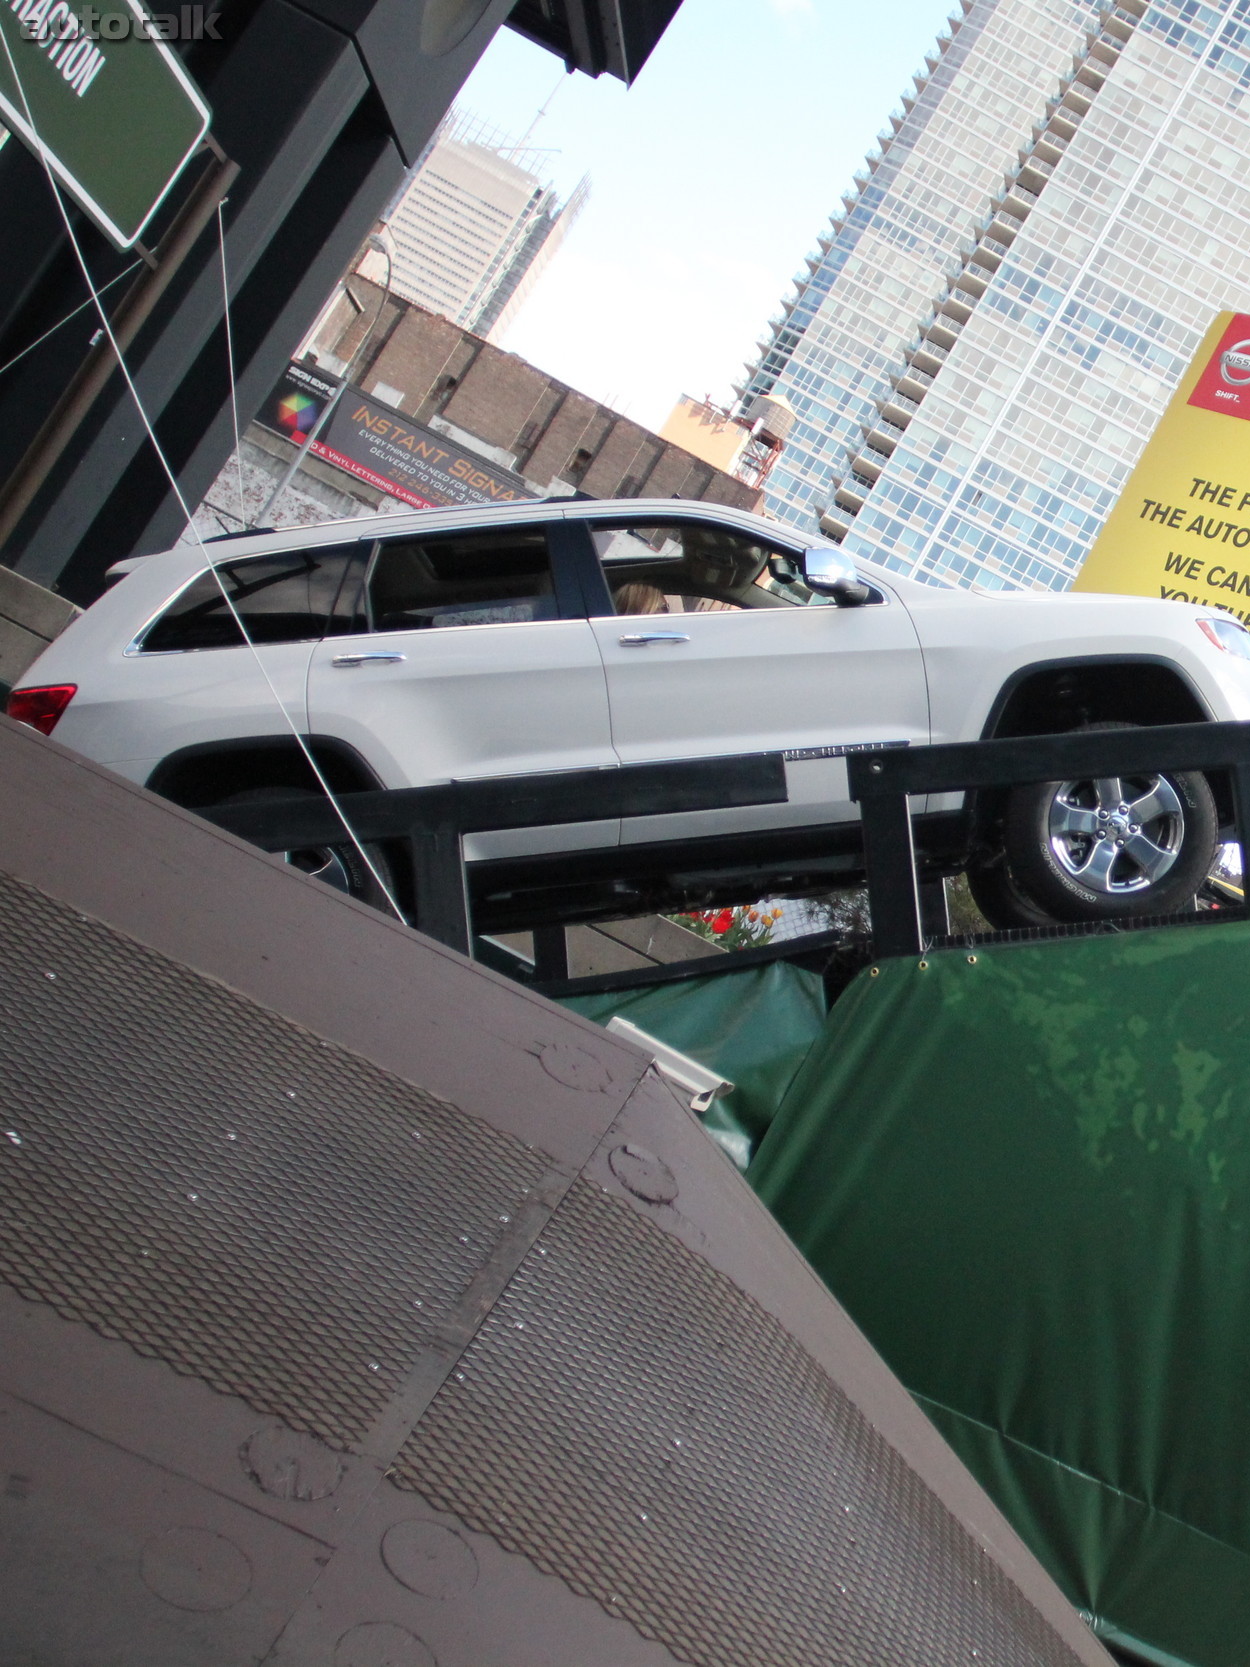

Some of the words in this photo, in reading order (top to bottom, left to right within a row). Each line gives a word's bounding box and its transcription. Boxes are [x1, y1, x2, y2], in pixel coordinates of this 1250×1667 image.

[352, 405, 449, 464] INSTANT
[358, 429, 410, 460] EVERYTHING
[411, 456, 429, 471] YOU
[427, 465, 449, 482] NEED
[450, 478, 468, 493] FOR
[369, 446, 416, 475] DELIVERED
[418, 471, 430, 483] TO
[430, 478, 448, 493] YOU
[446, 487, 456, 497] IN
[456, 490, 465, 502] 3
[387, 469, 406, 483] 212
[395, 488, 423, 506] LARGE
[1189, 477, 1237, 507] THE
[1139, 499, 1187, 529] THE
[1163, 551, 1205, 581] WE
